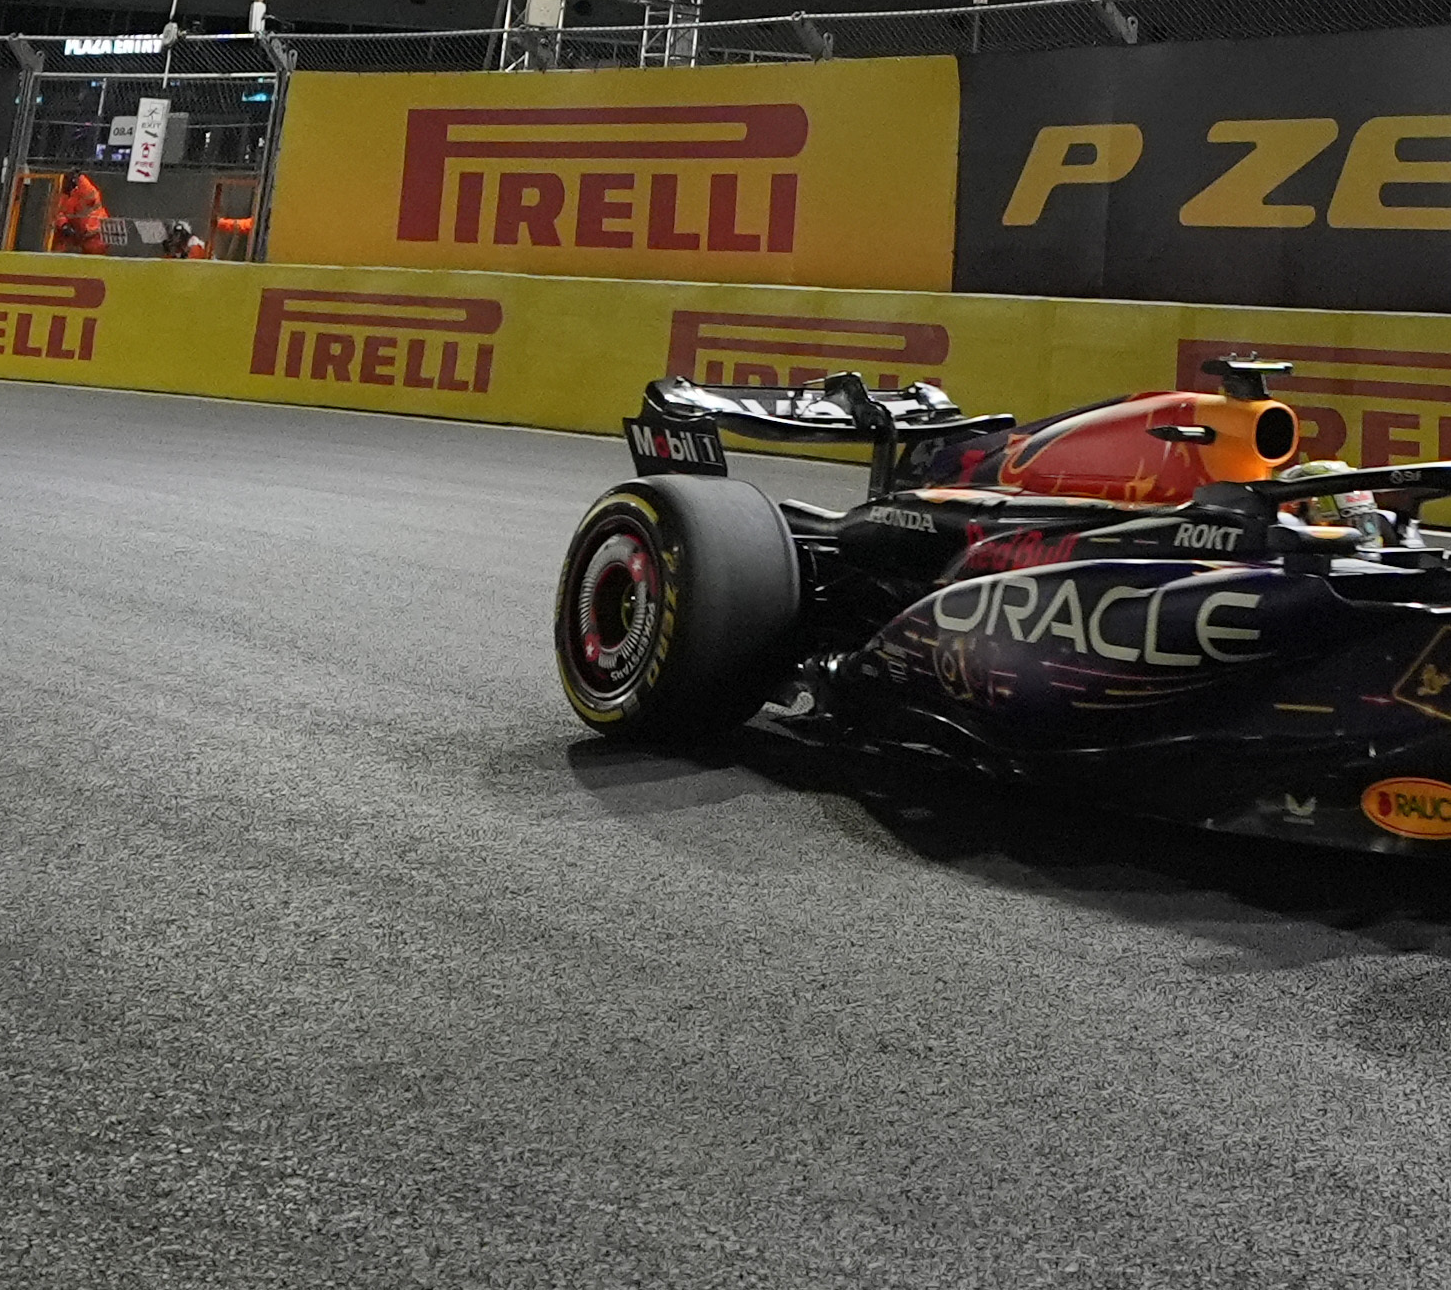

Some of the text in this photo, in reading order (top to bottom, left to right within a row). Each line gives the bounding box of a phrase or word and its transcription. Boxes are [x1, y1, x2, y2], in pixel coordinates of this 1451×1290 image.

[64, 38, 112, 56] PLAZA
[396, 103, 809, 253] PIRELLI
[1002, 123, 1143, 227] P
[250, 288, 503, 393] PIRELLI
[631, 424, 697, 462] Mobil
[865, 506, 937, 534] HONDA
[1174, 522, 1243, 552] ROKT
[933, 573, 1266, 667] ORACLE
